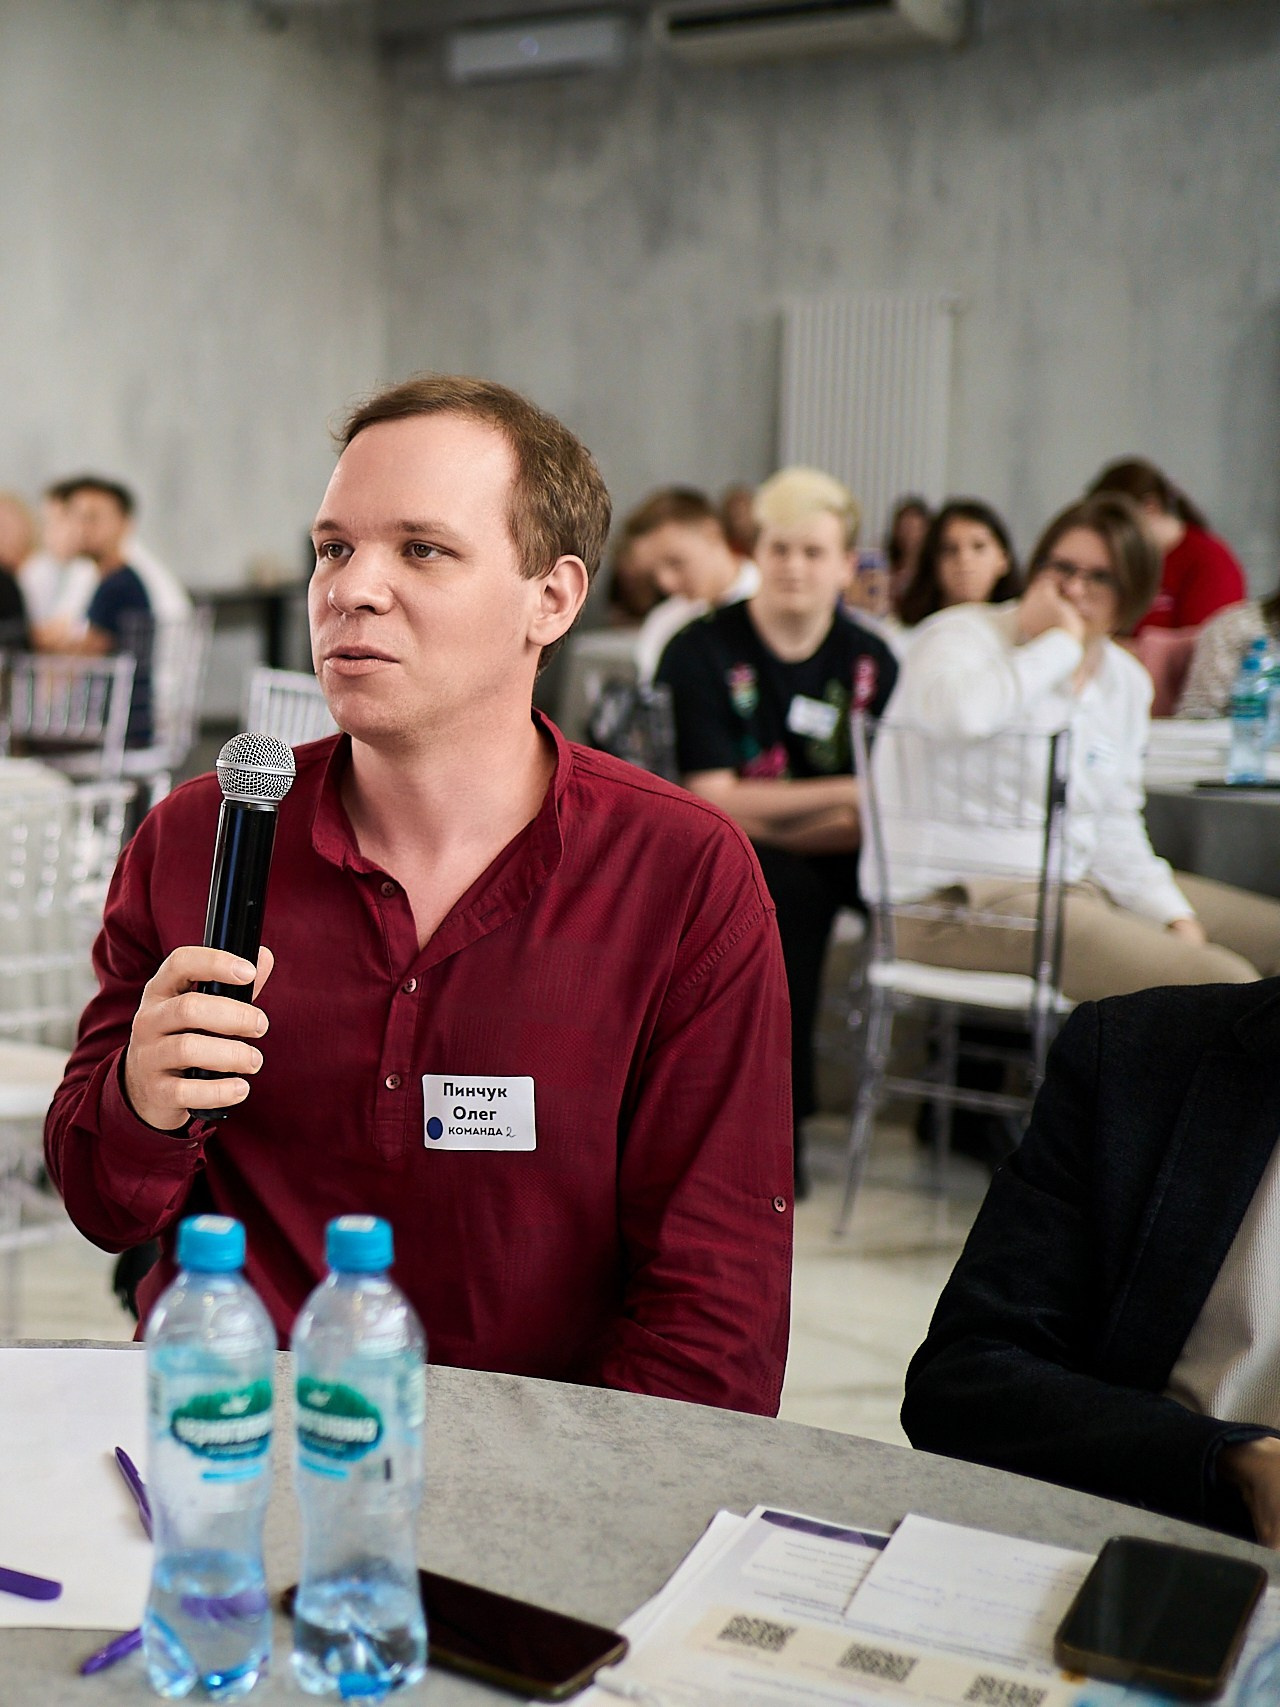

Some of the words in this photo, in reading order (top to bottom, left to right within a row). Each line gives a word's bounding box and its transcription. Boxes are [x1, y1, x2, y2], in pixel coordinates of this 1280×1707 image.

[443, 1082, 508, 1102] Пинчук
[453, 1105, 497, 1121] Олег
[448, 1126, 503, 1137] КОМАНДА
[505, 1126, 517, 1138] 2
